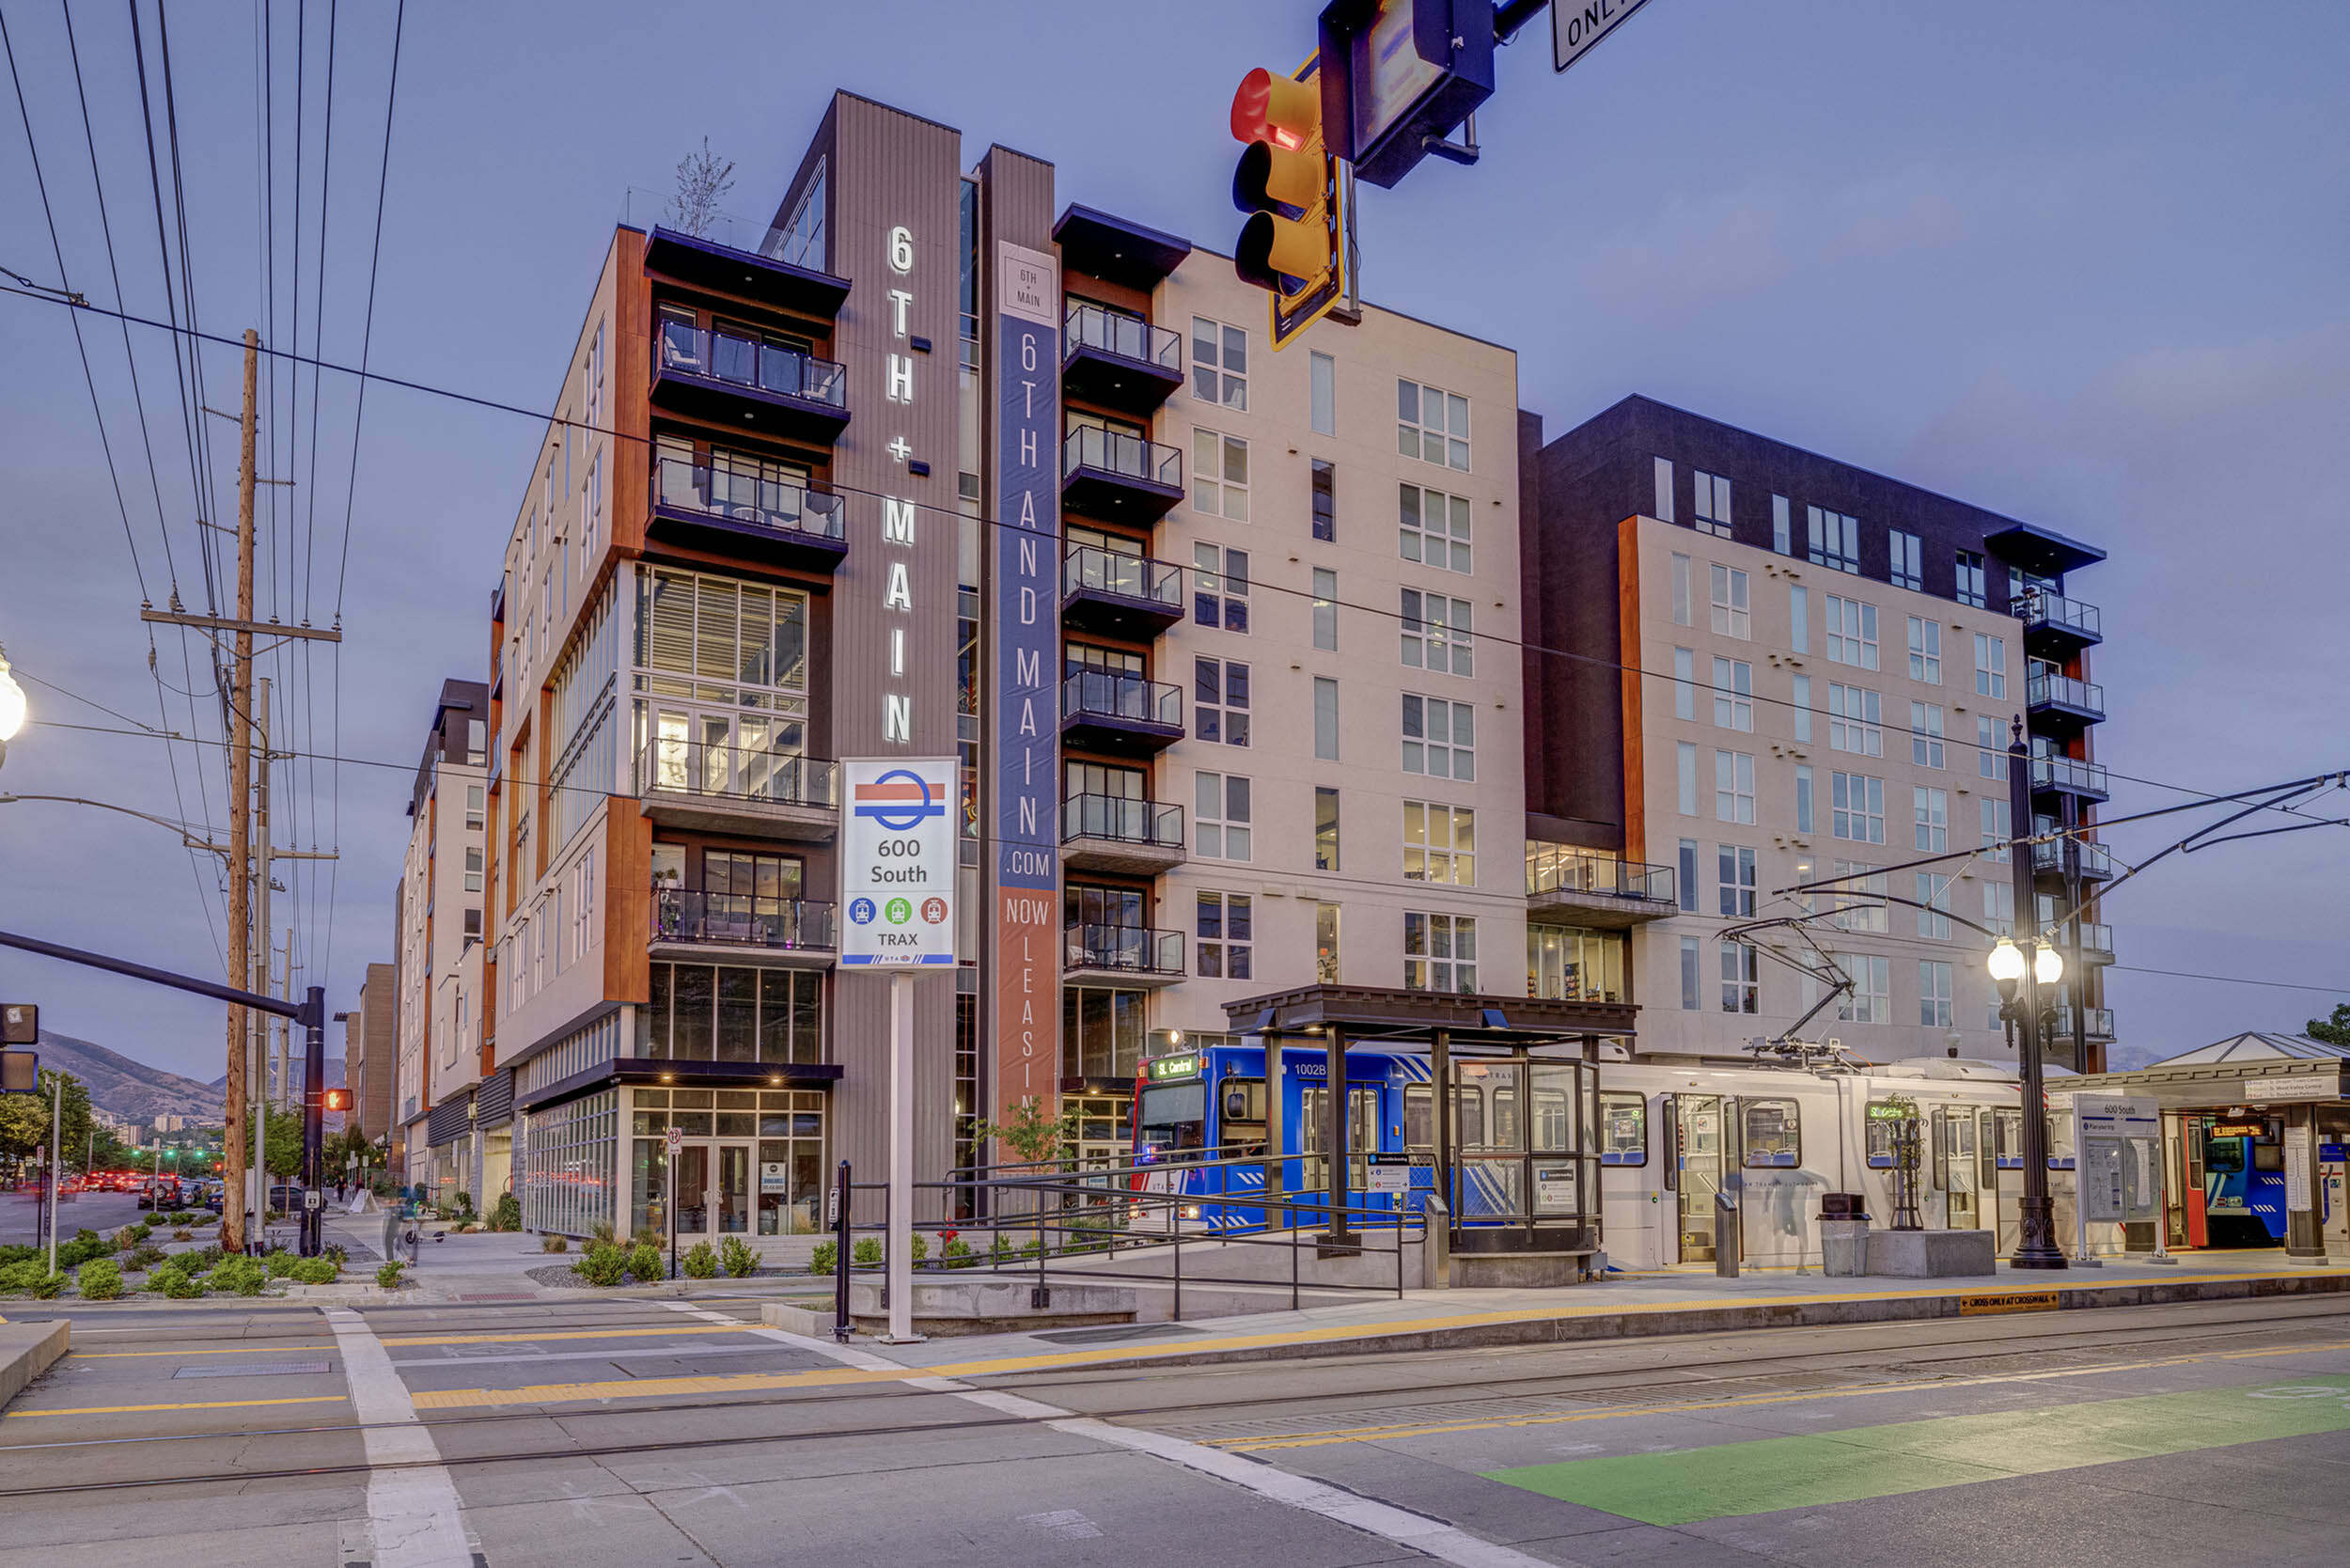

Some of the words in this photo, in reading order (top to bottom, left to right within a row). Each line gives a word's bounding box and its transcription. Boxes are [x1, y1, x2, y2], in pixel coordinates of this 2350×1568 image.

[1568, 0, 1624, 46] ONL
[1020, 269, 1037, 284] 6TH
[1017, 290, 1040, 307] MAIN
[887, 226, 913, 403] 6TH
[1021, 333, 1037, 468] 6TH
[1020, 490, 1037, 625] AND
[884, 495, 915, 743] MAIN
[1017, 647, 1040, 836] MAIN
[878, 839, 920, 857] 600
[870, 865, 927, 883] South
[1006, 851, 1050, 876] .COM
[1007, 899, 1049, 926] NOW
[877, 933, 918, 946] TRAX
[1022, 936, 1035, 1121] LEASIN
[1294, 1064, 1326, 1075] 1002B
[2105, 1105, 2118, 1113] 600
[2119, 1105, 2136, 1114] South
[1969, 1298, 1988, 1307] CROSS
[1989, 1297, 2004, 1306] ONLY
[2006, 1296, 2013, 1305] AT
[2014, 1294, 2049, 1305] CROSSWALK
